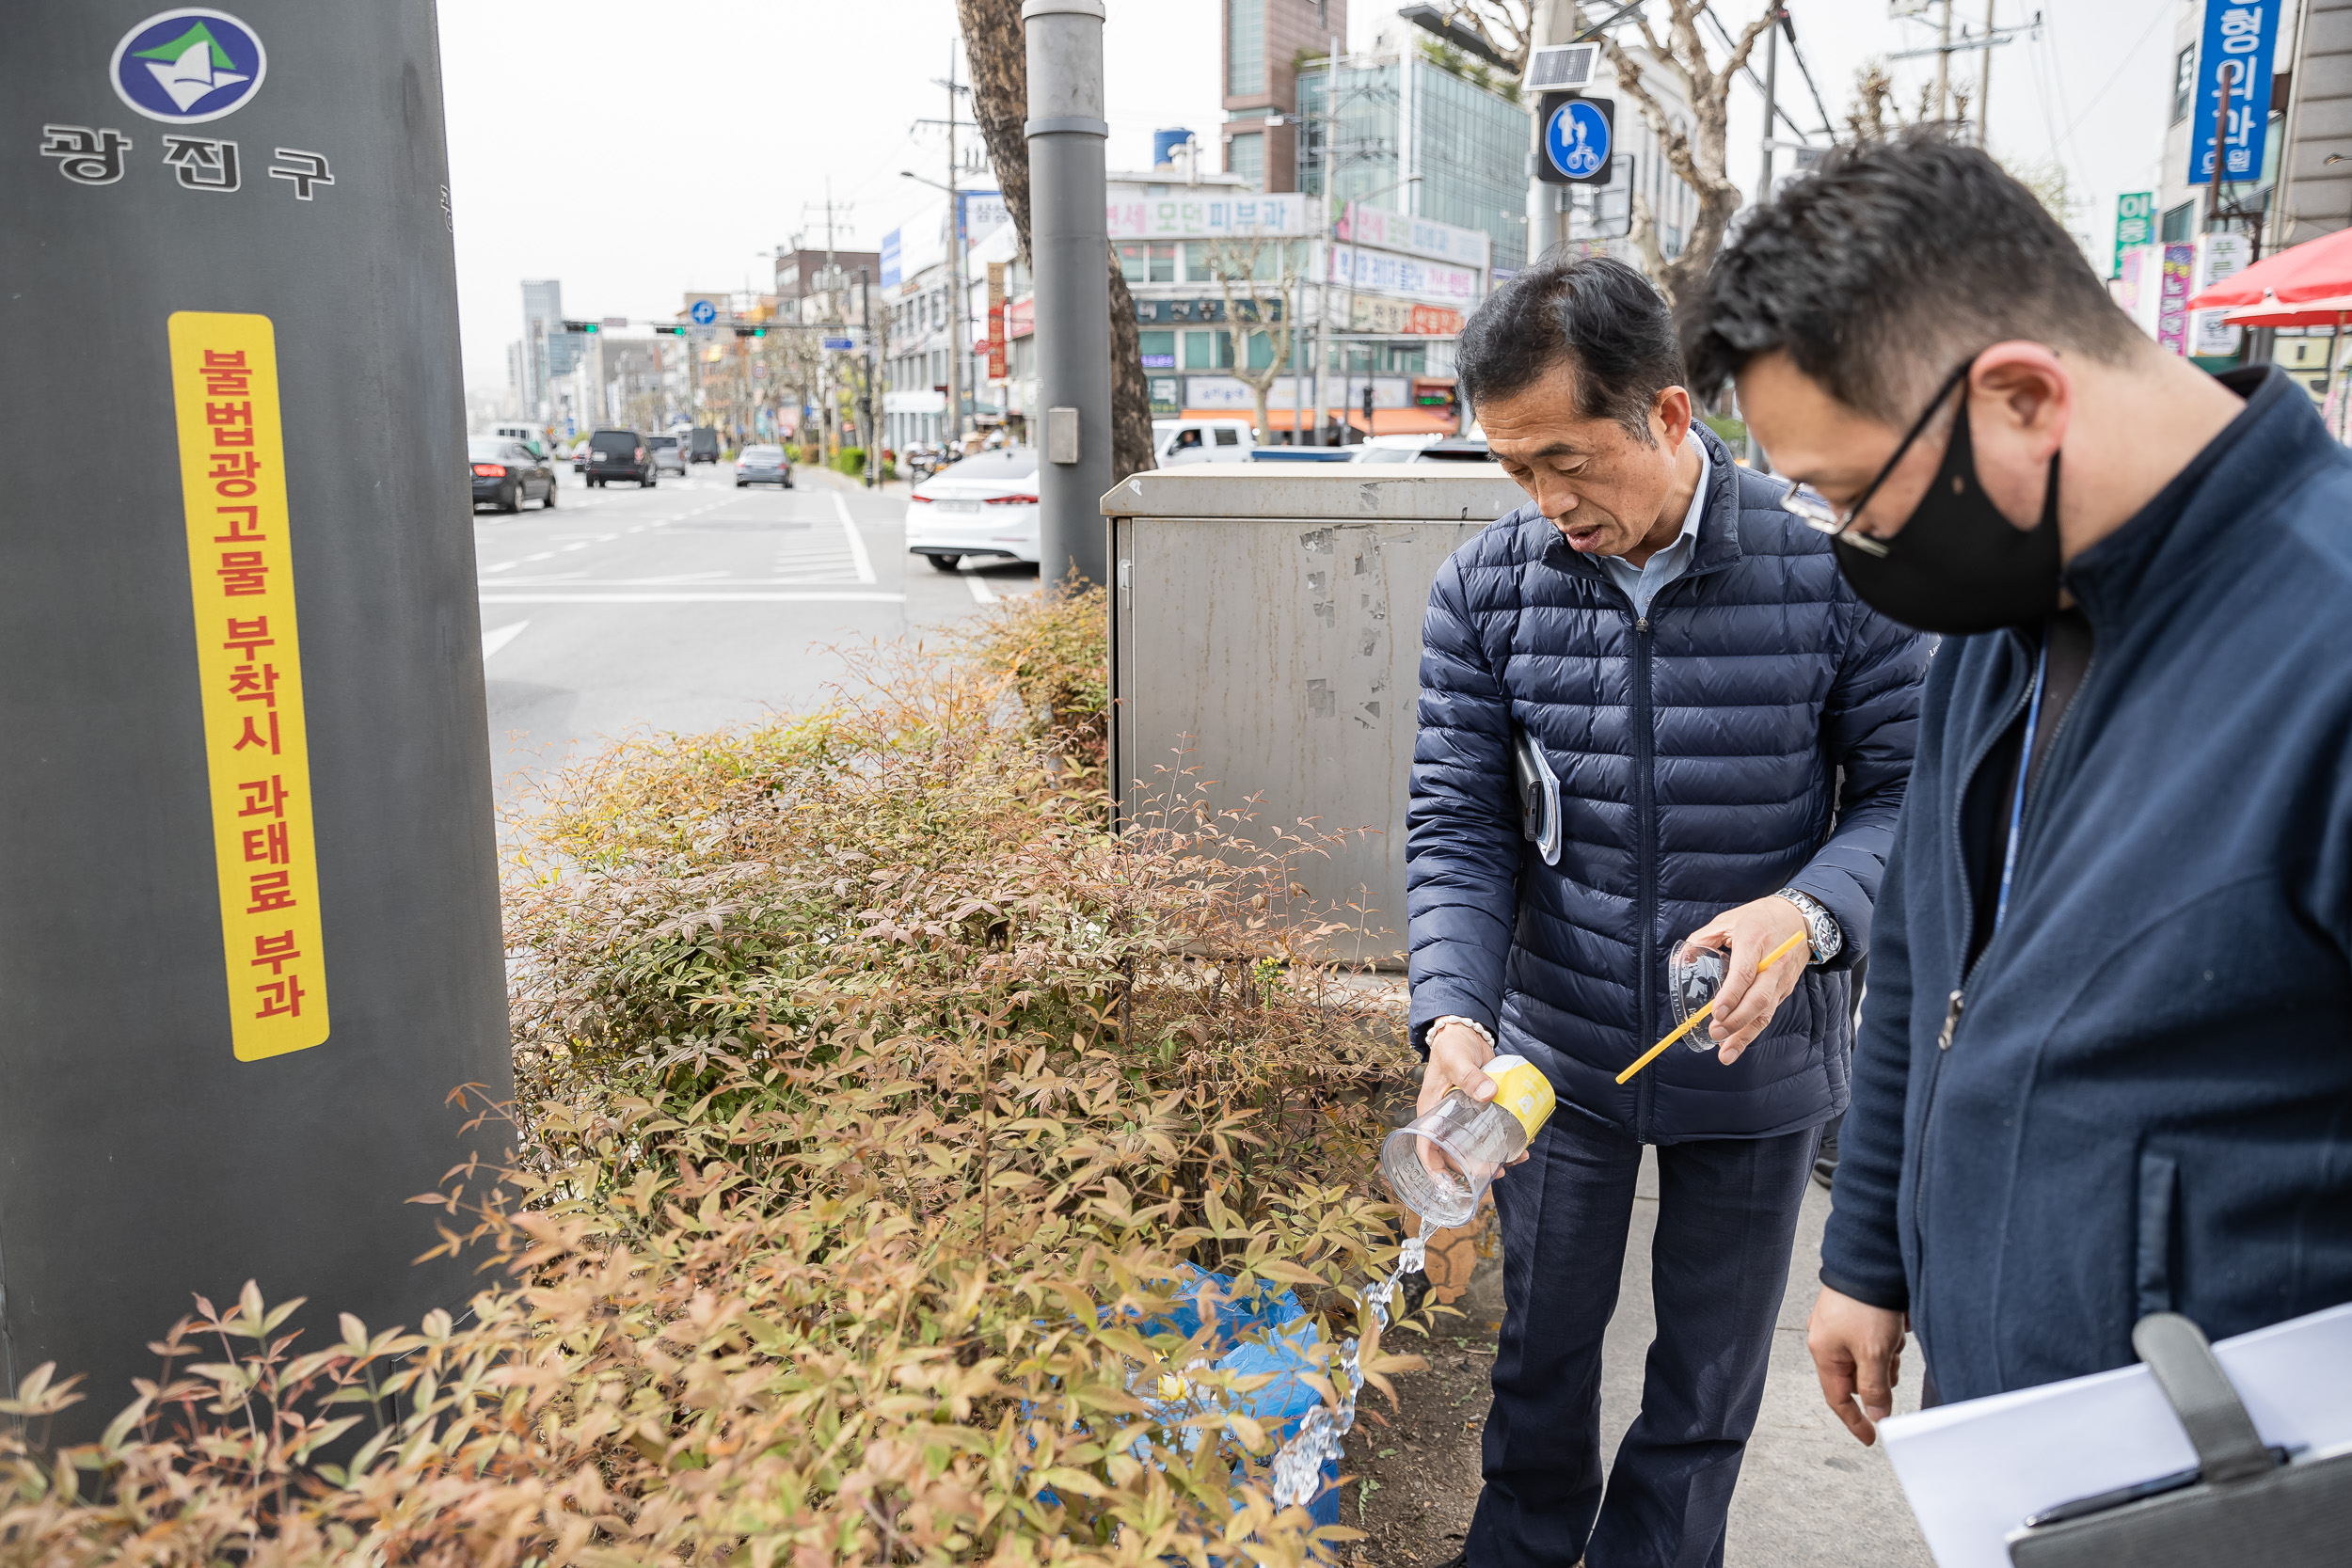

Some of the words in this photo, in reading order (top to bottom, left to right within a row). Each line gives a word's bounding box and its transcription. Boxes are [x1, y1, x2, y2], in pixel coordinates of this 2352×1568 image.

[2207, 0, 2264, 148] 형외과
[40, 124, 335, 201] 광진구
[1209, 200, 1286, 232] 피부과
[199, 349, 270, 597] 불법광고물
[223, 615, 282, 756] 부착시
[237, 774, 297, 915] 과태료
[250, 928, 306, 1020] 부과
